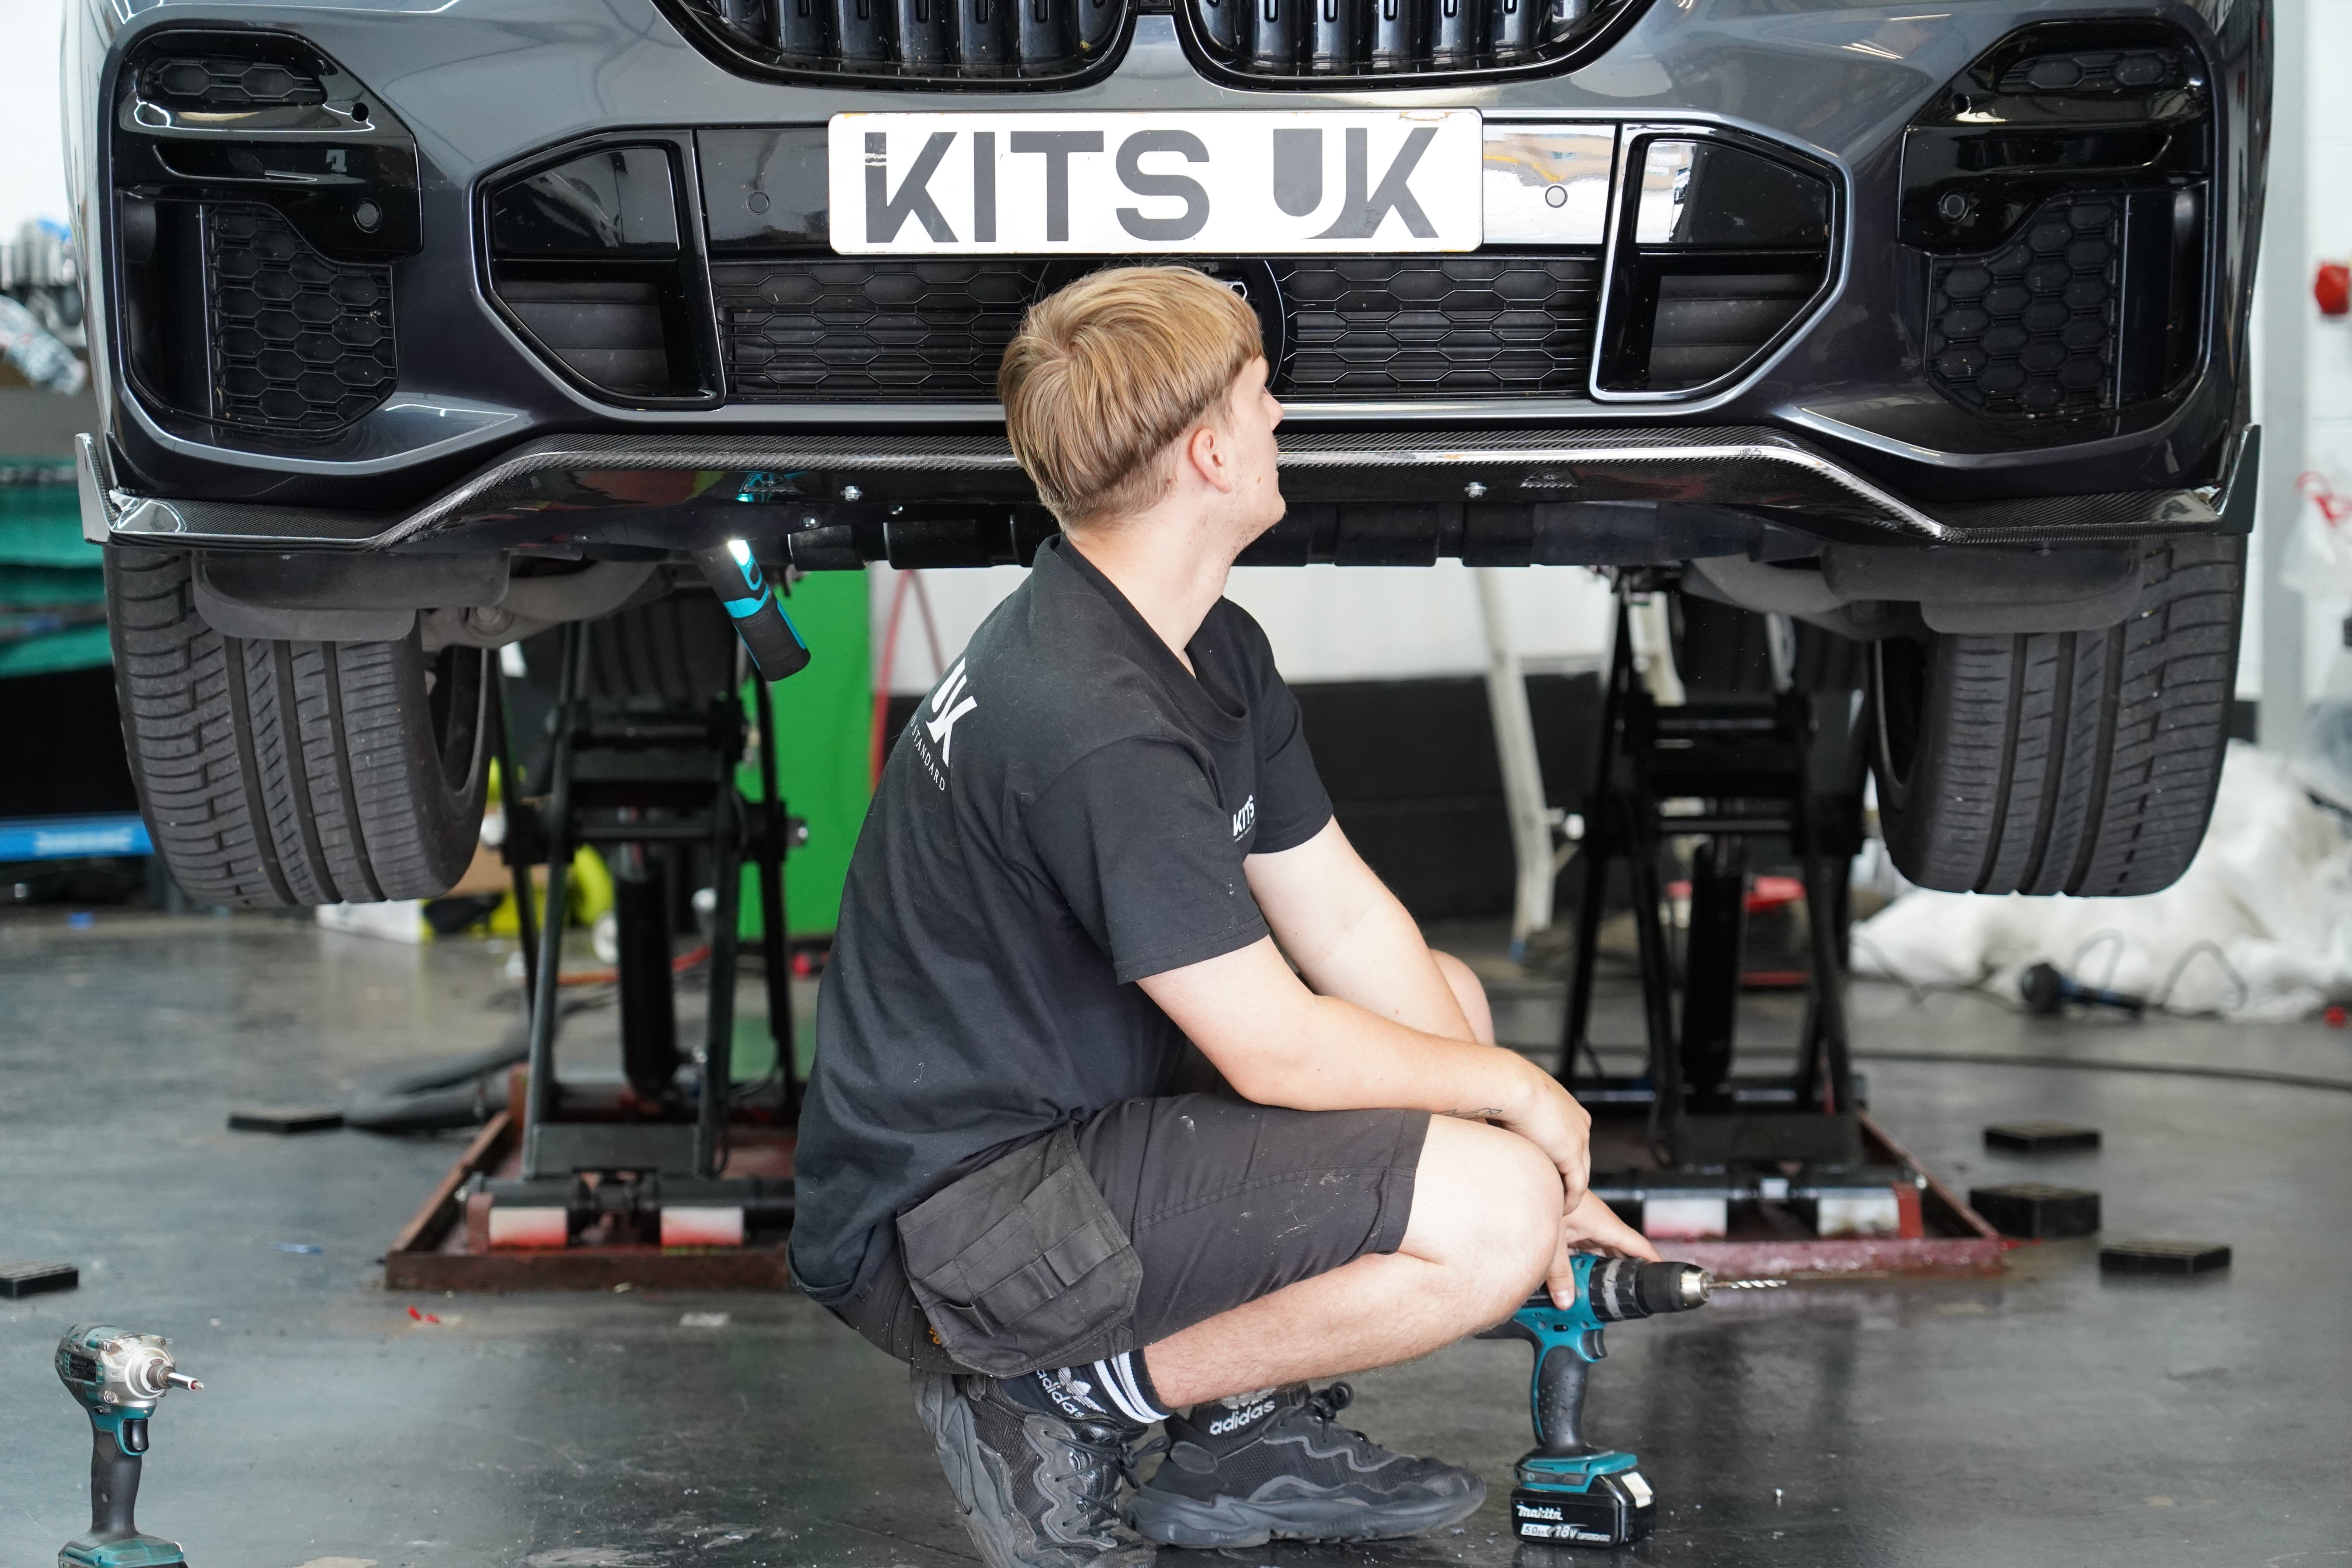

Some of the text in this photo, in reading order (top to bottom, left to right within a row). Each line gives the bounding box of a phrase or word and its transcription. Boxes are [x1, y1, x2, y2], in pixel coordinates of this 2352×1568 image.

[865, 127, 1439, 243] KITS UK
[925, 657, 978, 768] UK
[912, 724, 946, 791] STANDARD
[1233, 794, 1254, 837] KITS
[1209, 1400, 1276, 1436] adidas
